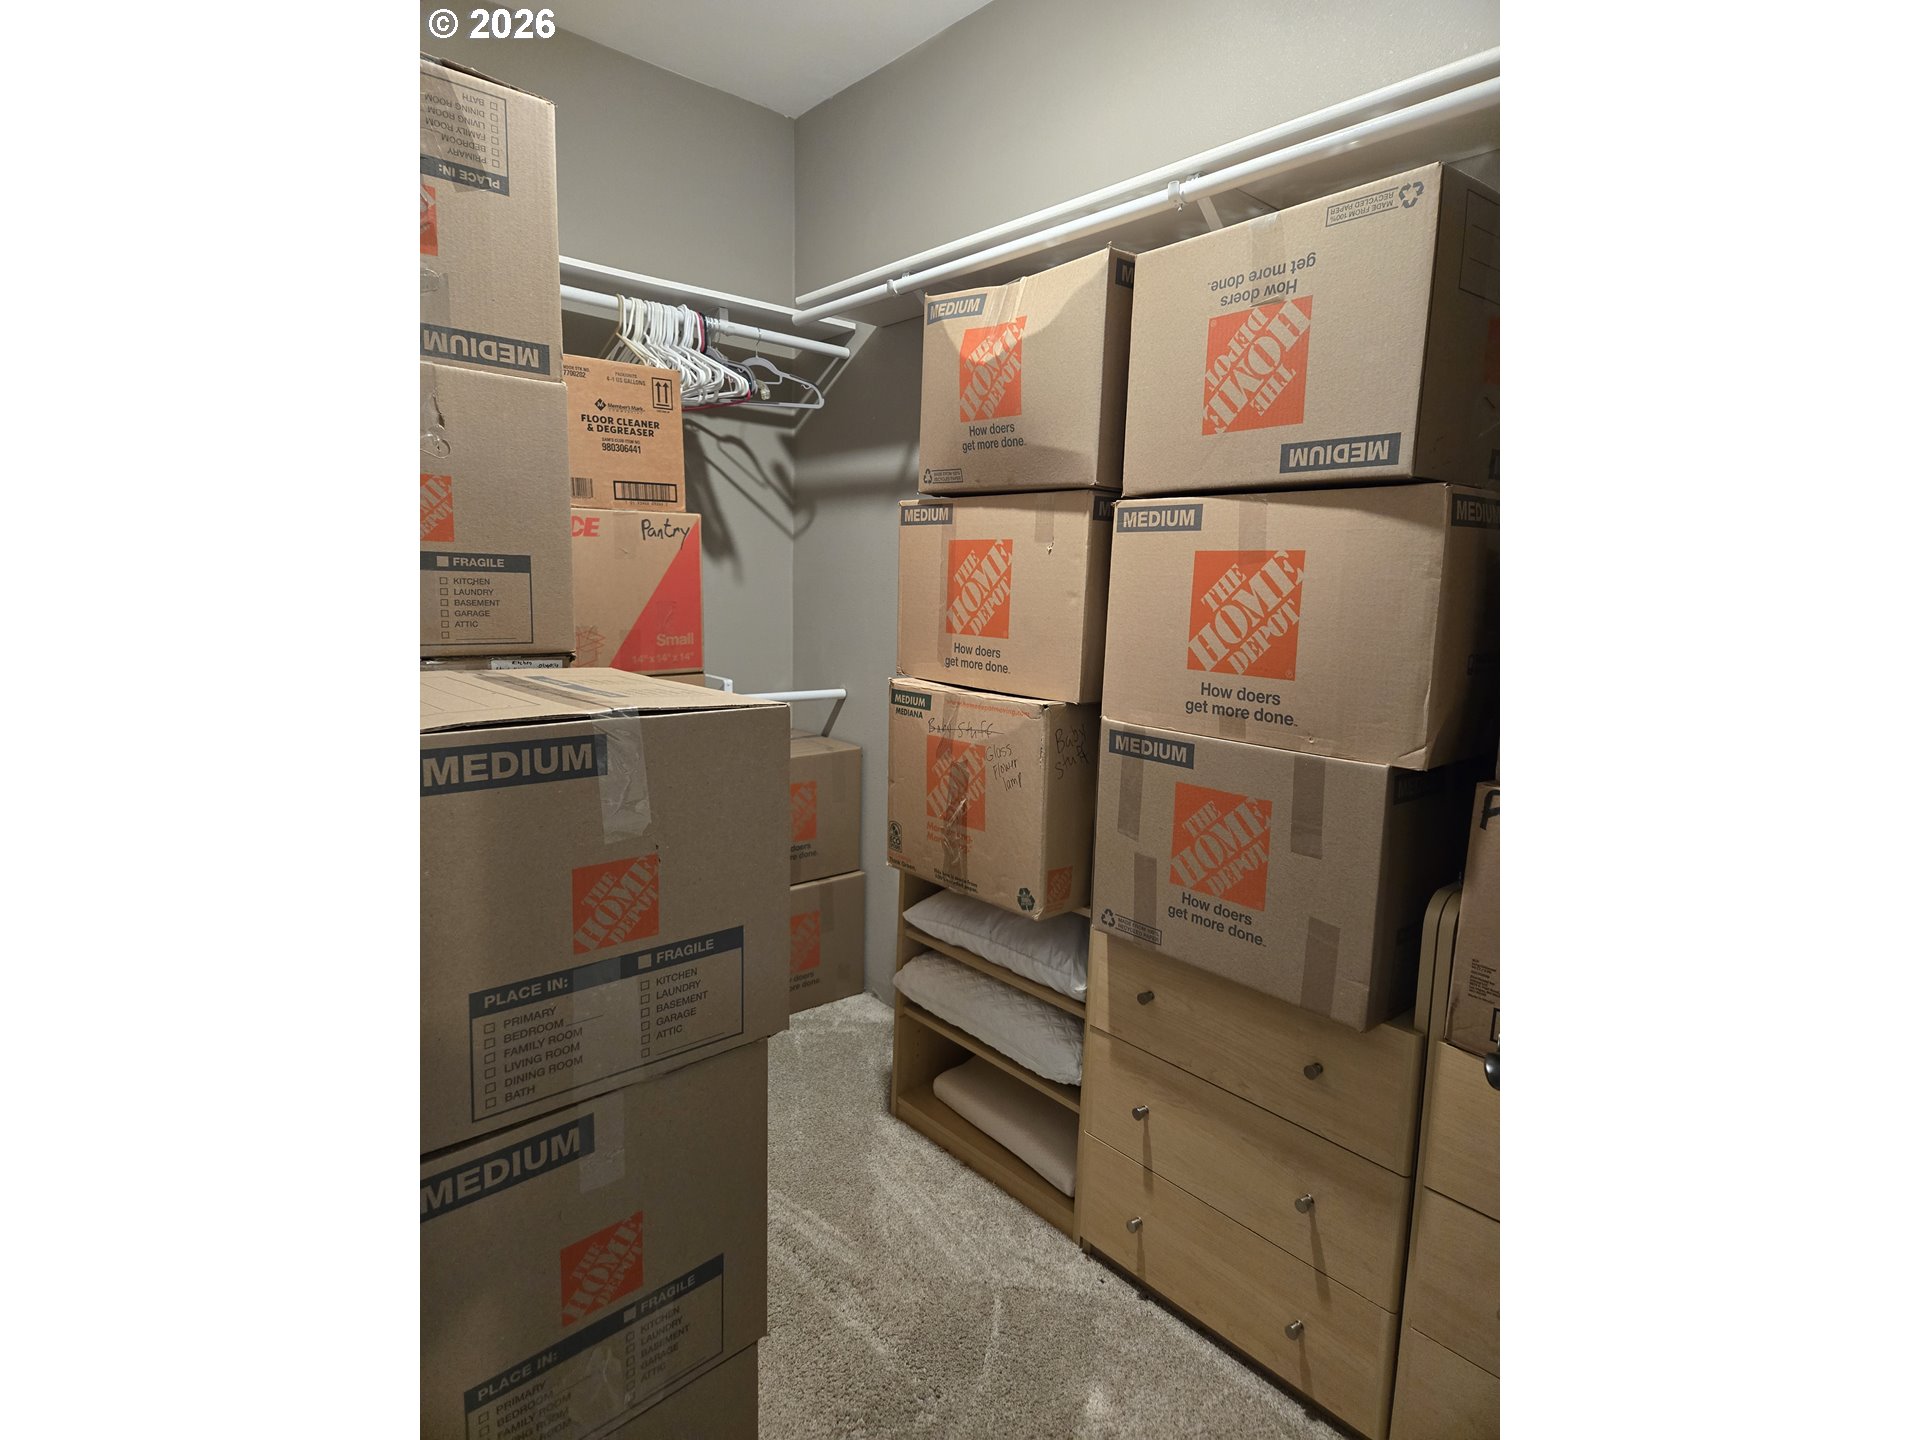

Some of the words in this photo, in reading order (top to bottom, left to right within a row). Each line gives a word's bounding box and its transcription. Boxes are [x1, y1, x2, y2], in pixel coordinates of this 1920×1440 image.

[455, 103, 486, 118] DINING
[462, 93, 485, 105] BATH
[455, 127, 486, 141] FAMILY
[457, 115, 486, 129] LIVING
[441, 134, 487, 152] BEDROOM
[447, 148, 487, 163] PRIMARY
[459, 167, 501, 189] PLACE
[1330, 203, 1354, 215] PAPER
[1348, 206, 1371, 218] FROM
[1371, 199, 1394, 212] MADE
[1249, 263, 1287, 282] more
[1290, 252, 1316, 274] get
[1220, 288, 1260, 307] doers
[1264, 279, 1298, 297] How
[930, 298, 981, 319] MEDIUM
[424, 330, 539, 368] MEDIUM
[965, 335, 994, 372] THE
[1205, 307, 1269, 392] DEPOT
[960, 319, 1026, 421] HOME
[1203, 299, 1311, 434] HOME
[982, 352, 1021, 418] DEPOT
[1250, 363, 1297, 416] THE
[580, 413, 614, 425] FLOOR
[616, 417, 660, 430] CLEANER
[587, 424, 594, 432] &
[597, 424, 655, 438] DEGREASER
[969, 424, 988, 437] How
[990, 422, 1015, 434] doers
[602, 443, 641, 454] 980306441
[962, 440, 976, 453] get
[977, 439, 999, 451] more
[1289, 439, 1390, 468] MEDIUM
[904, 508, 949, 522] MEDIUM
[1123, 509, 1196, 528] MEDIUM
[641, 518, 690, 550] Pantry
[452, 557, 505, 568] FRAGILE
[953, 550, 980, 587] THE
[453, 578, 491, 586] KITCHEN
[454, 588, 494, 597] LAUNDRY
[946, 540, 1013, 634] HOME
[1201, 563, 1247, 614] THE
[454, 599, 500, 607] BASEMENT
[969, 575, 1010, 636] DEPOT
[1187, 550, 1305, 672] HOME
[656, 632, 694, 647] Small
[1227, 598, 1300, 675] DEPOT
[954, 642, 973, 654] How
[975, 645, 1001, 658] doers
[944, 656, 958, 668] get
[960, 659, 983, 670] more
[895, 694, 926, 707] MEDIUM
[1200, 681, 1233, 699] How
[1236, 687, 1281, 706] doers
[896, 707, 923, 719] MEDIANA
[1185, 700, 1208, 715] get
[1211, 703, 1249, 720] more
[1115, 735, 1187, 763] MEDIUM
[422, 743, 593, 787] MEDIUM
[1182, 801, 1222, 838] THE
[1171, 798, 1270, 888] HOME
[1206, 840, 1268, 898] DEPOT
[582, 872, 617, 908] THE
[575, 857, 657, 950] HOME
[608, 884, 657, 943] DEPOT
[1182, 892, 1210, 911] How
[1213, 903, 1252, 927] doers
[1168, 905, 1188, 921] get
[1191, 912, 1224, 933] more
[656, 938, 715, 964] FRAGILE
[655, 967, 698, 987] KITCHEN
[483, 984, 542, 1009] PLACE
[547, 977, 569, 993] IN:
[656, 979, 701, 1000] LAUNDRY
[656, 991, 709, 1013] BASEMENT
[503, 1006, 557, 1029] PRIMARY
[656, 1007, 697, 1026] GARAGE
[503, 1018, 565, 1044] BEDROOM
[503, 1038, 545, 1059] FAMILY
[547, 1027, 583, 1046] ROOM
[656, 1024, 683, 1040] ATTIC
[504, 1053, 543, 1074] LIVING
[545, 1042, 580, 1061] ROOM
[504, 1067, 546, 1088] DINING
[549, 1055, 584, 1074] ROOM
[504, 1086, 536, 1102] BATH
[420, 1127, 580, 1214] MEDIUM
[562, 1217, 643, 1317] HOME
[640, 1274, 696, 1313] FRAGILE
[640, 1305, 680, 1334] KITCHEN
[478, 1363, 532, 1402] PLACE
[536, 1351, 560, 1370] IN:
[496, 1380, 546, 1416] PRIMARY
[497, 1390, 553, 1428] BEDROOM
